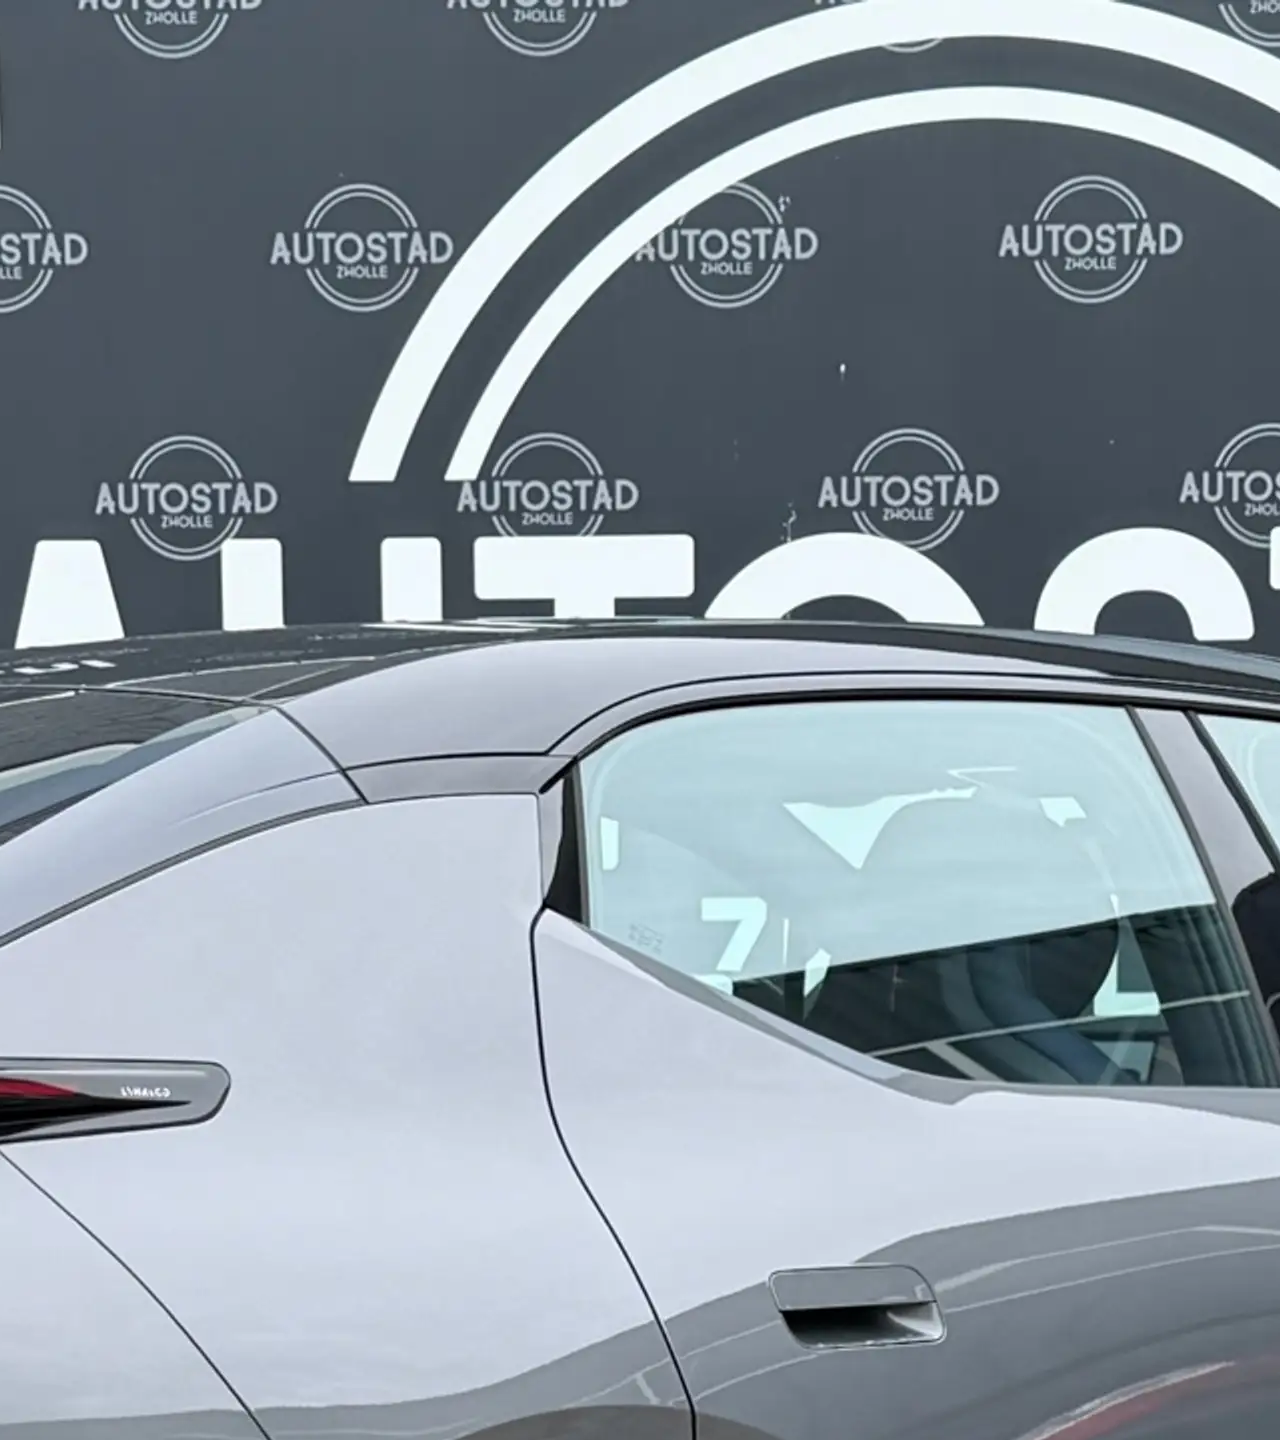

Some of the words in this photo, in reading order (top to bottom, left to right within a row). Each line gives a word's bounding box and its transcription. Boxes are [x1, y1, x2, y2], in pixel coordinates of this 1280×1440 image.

[270, 232, 454, 265] AUTOSTAD
[999, 222, 1183, 257] AUTOSTAD
[95, 482, 278, 515] AUTOSTAD
[456, 478, 639, 512] AUTOSTAD
[818, 474, 1000, 508] AUTOSTAD
